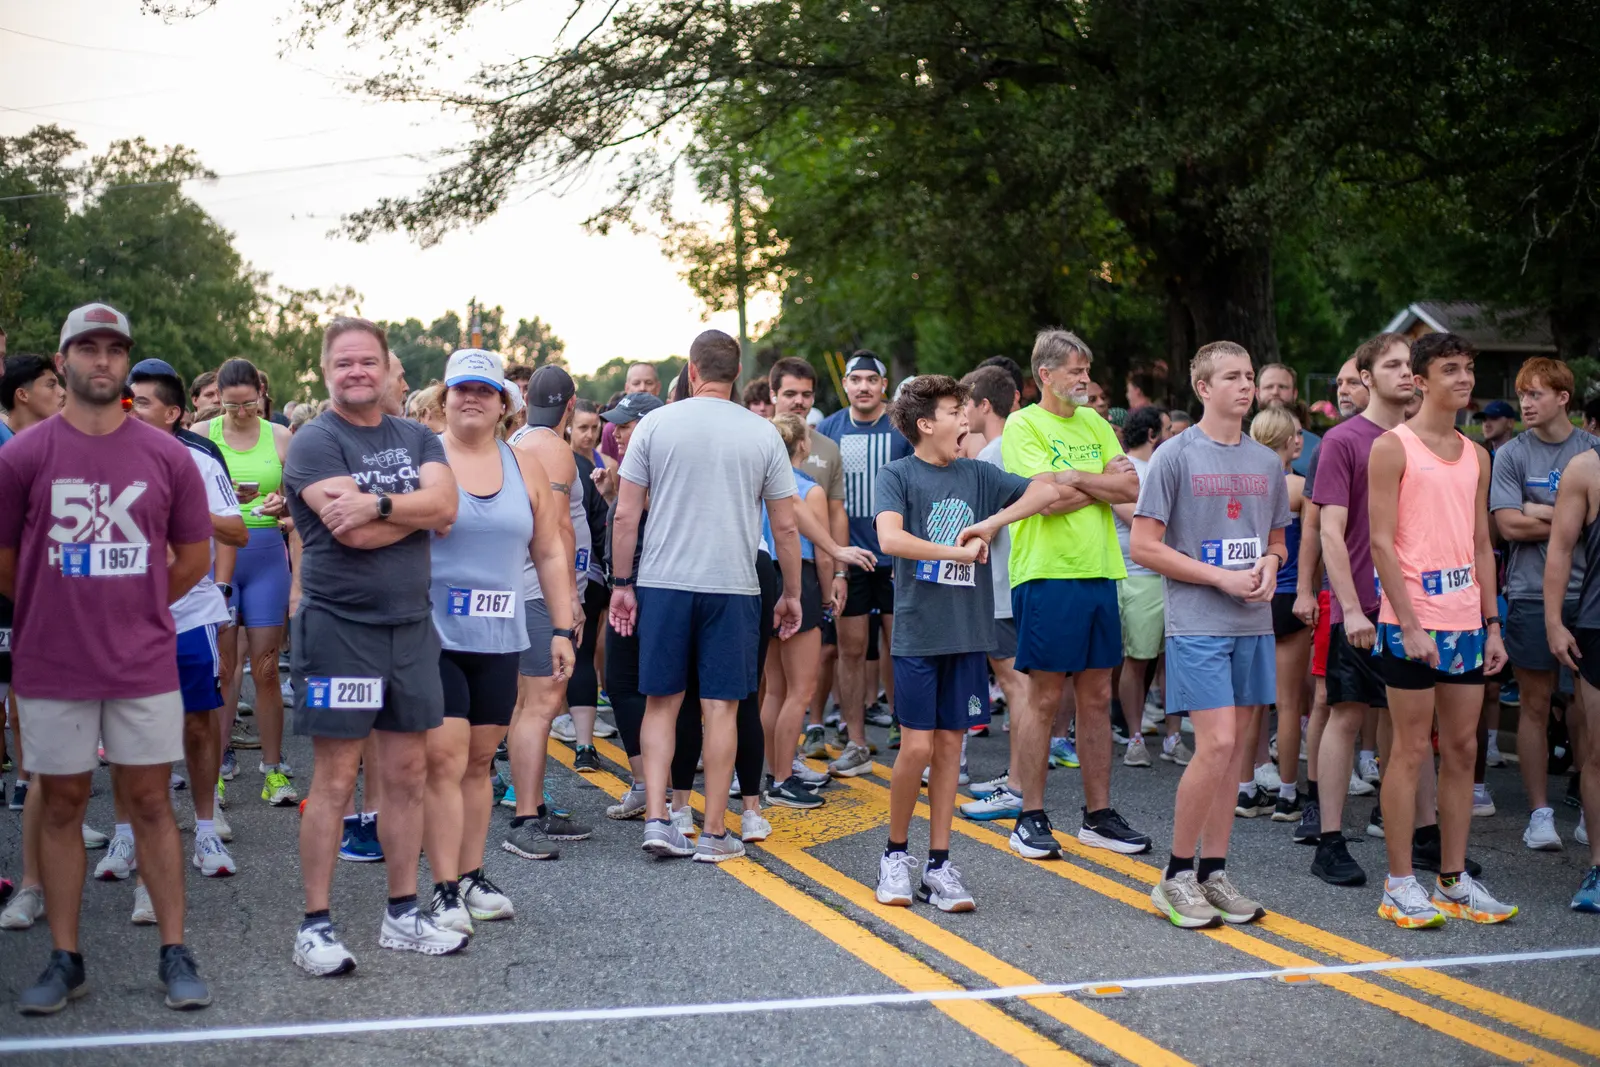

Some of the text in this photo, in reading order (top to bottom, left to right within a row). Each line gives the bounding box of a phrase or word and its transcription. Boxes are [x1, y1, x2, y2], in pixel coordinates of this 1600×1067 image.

[399, 465, 420, 480] Clu
[47, 484, 147, 543] 5K
[99, 547, 141, 570] 1957
[1228, 541, 1257, 560] 2200
[944, 562, 971, 582] 2136
[476, 593, 511, 612] 2167
[338, 682, 372, 703] 2201
